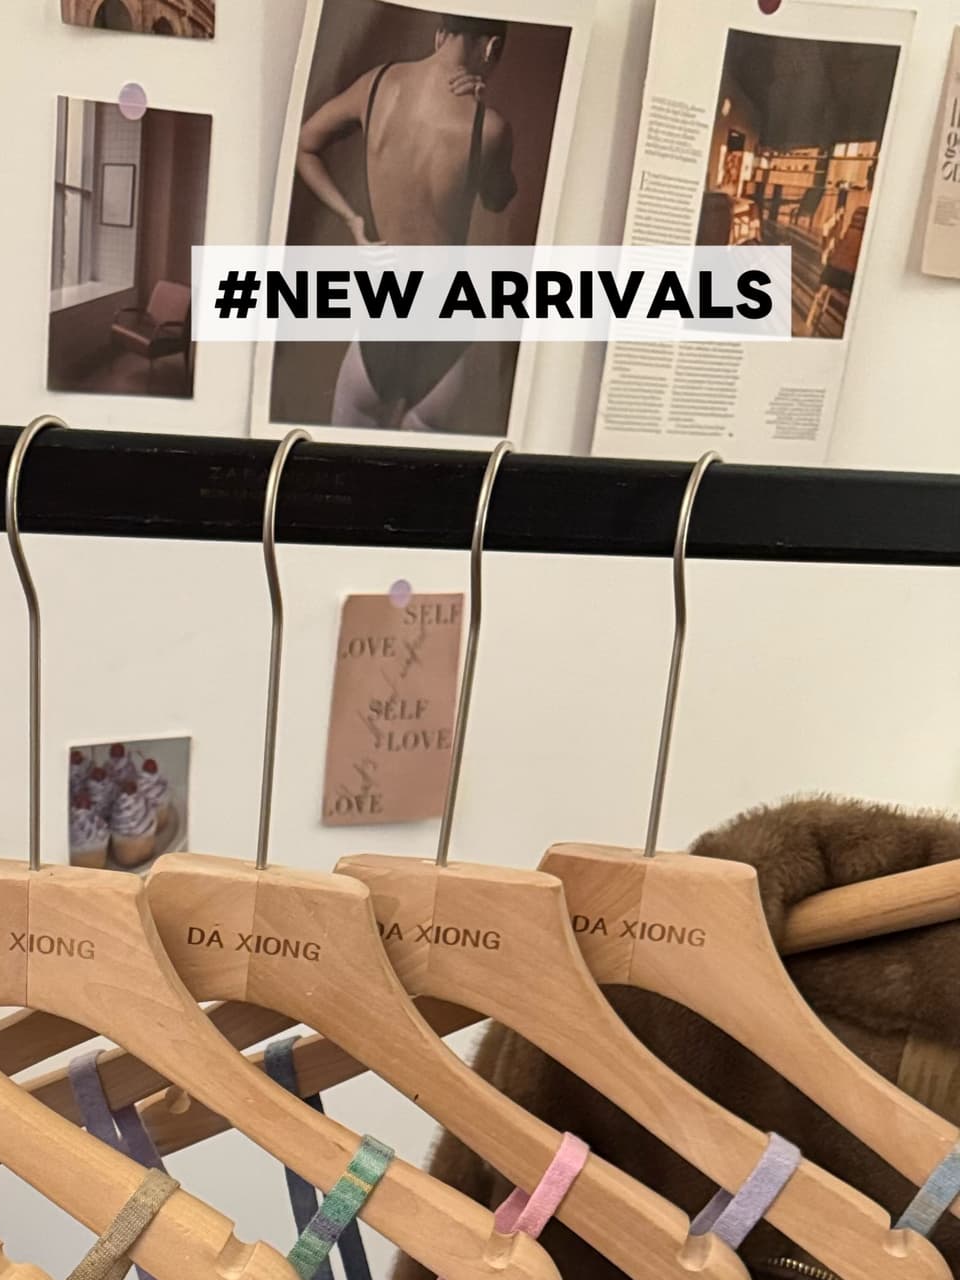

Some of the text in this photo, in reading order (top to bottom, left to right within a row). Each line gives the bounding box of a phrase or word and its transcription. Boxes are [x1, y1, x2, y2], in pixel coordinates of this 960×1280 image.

[341, 638, 396, 659] OVE
[369, 699, 429, 721] SELF
[386, 730, 451, 753] LOVE
[330, 794, 383, 817] OVE
[414, 923, 502, 951] XIONG
[572, 914, 707, 948] DA XIONG
[8, 931, 96, 960] XIONG
[187, 926, 322, 962] DA XIONG
